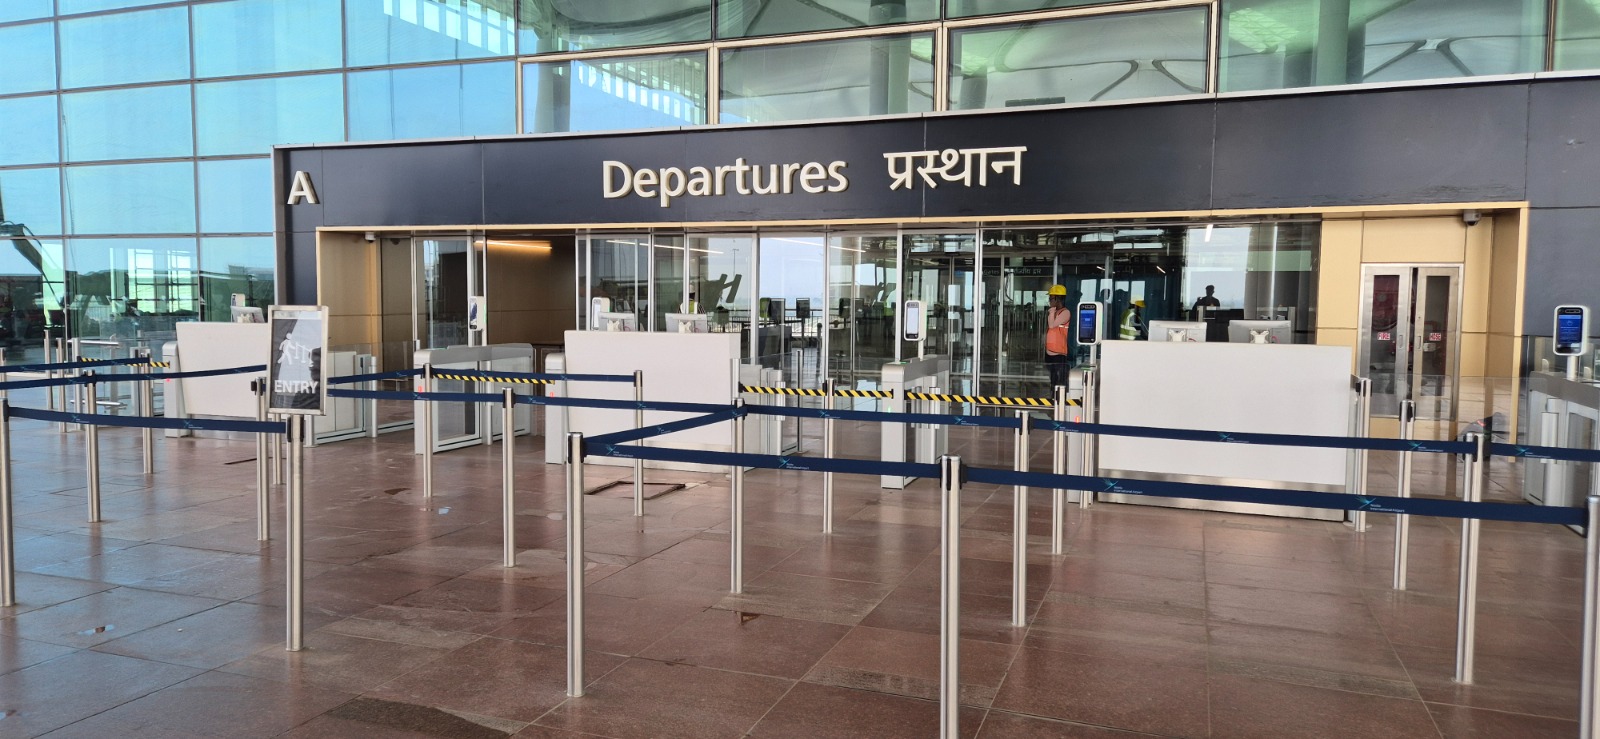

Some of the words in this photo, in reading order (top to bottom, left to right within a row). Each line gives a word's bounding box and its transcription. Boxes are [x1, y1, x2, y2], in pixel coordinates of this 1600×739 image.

[287, 170, 320, 205] A
[602, 156, 849, 208] Departures
[883, 145, 1027, 191] प्रस्थान
[274, 379, 319, 394] ENTRY
